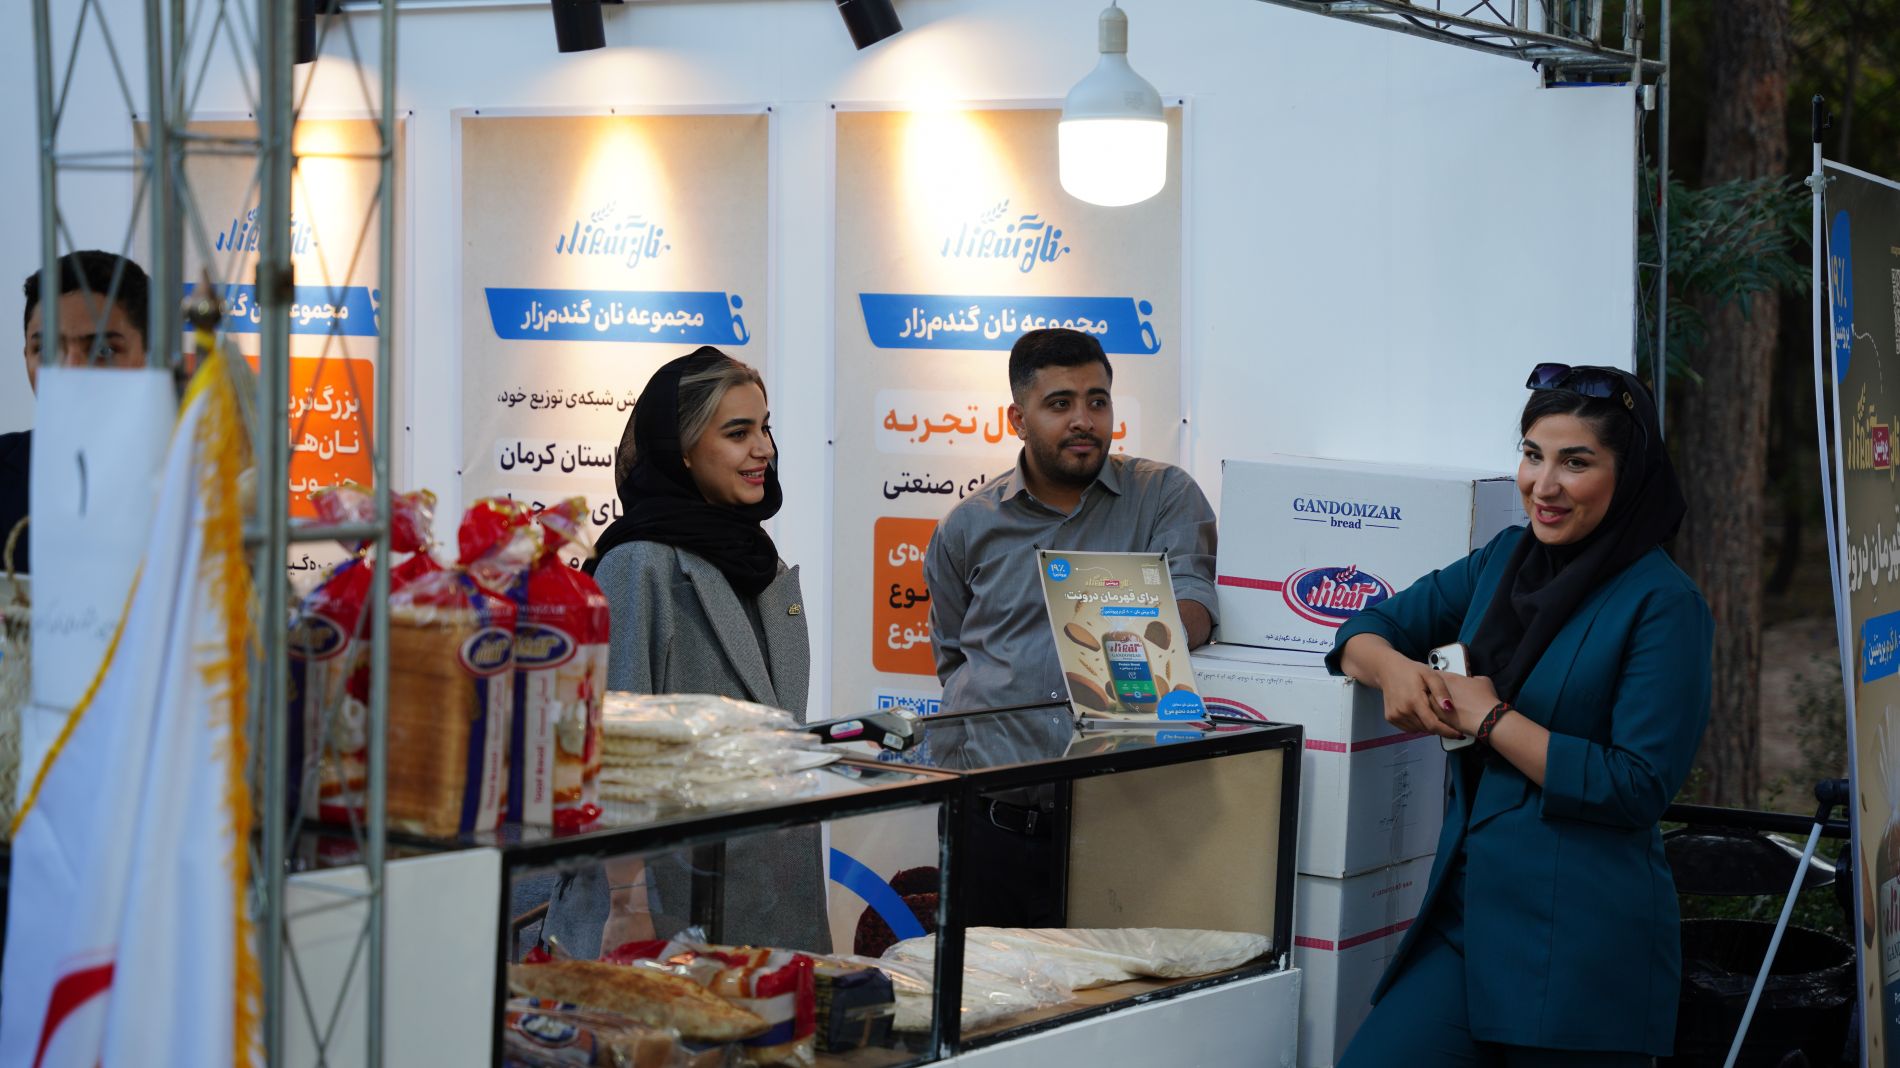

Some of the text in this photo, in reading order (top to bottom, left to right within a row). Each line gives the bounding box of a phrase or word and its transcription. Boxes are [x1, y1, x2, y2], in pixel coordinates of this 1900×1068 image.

[291, 304, 349, 326] مجموع
[594, 302, 624, 331] نان
[627, 308, 704, 334] مجموعه
[984, 308, 1017, 340] نان
[529, 389, 563, 410] توزیع
[883, 404, 978, 445] تجربه
[500, 442, 556, 472] کرمان
[883, 472, 955, 500] صنعتی
[1293, 497, 1402, 521] GANDOMZAR
[1330, 516, 1362, 530] bread
[1137, 592, 1159, 604] برای
